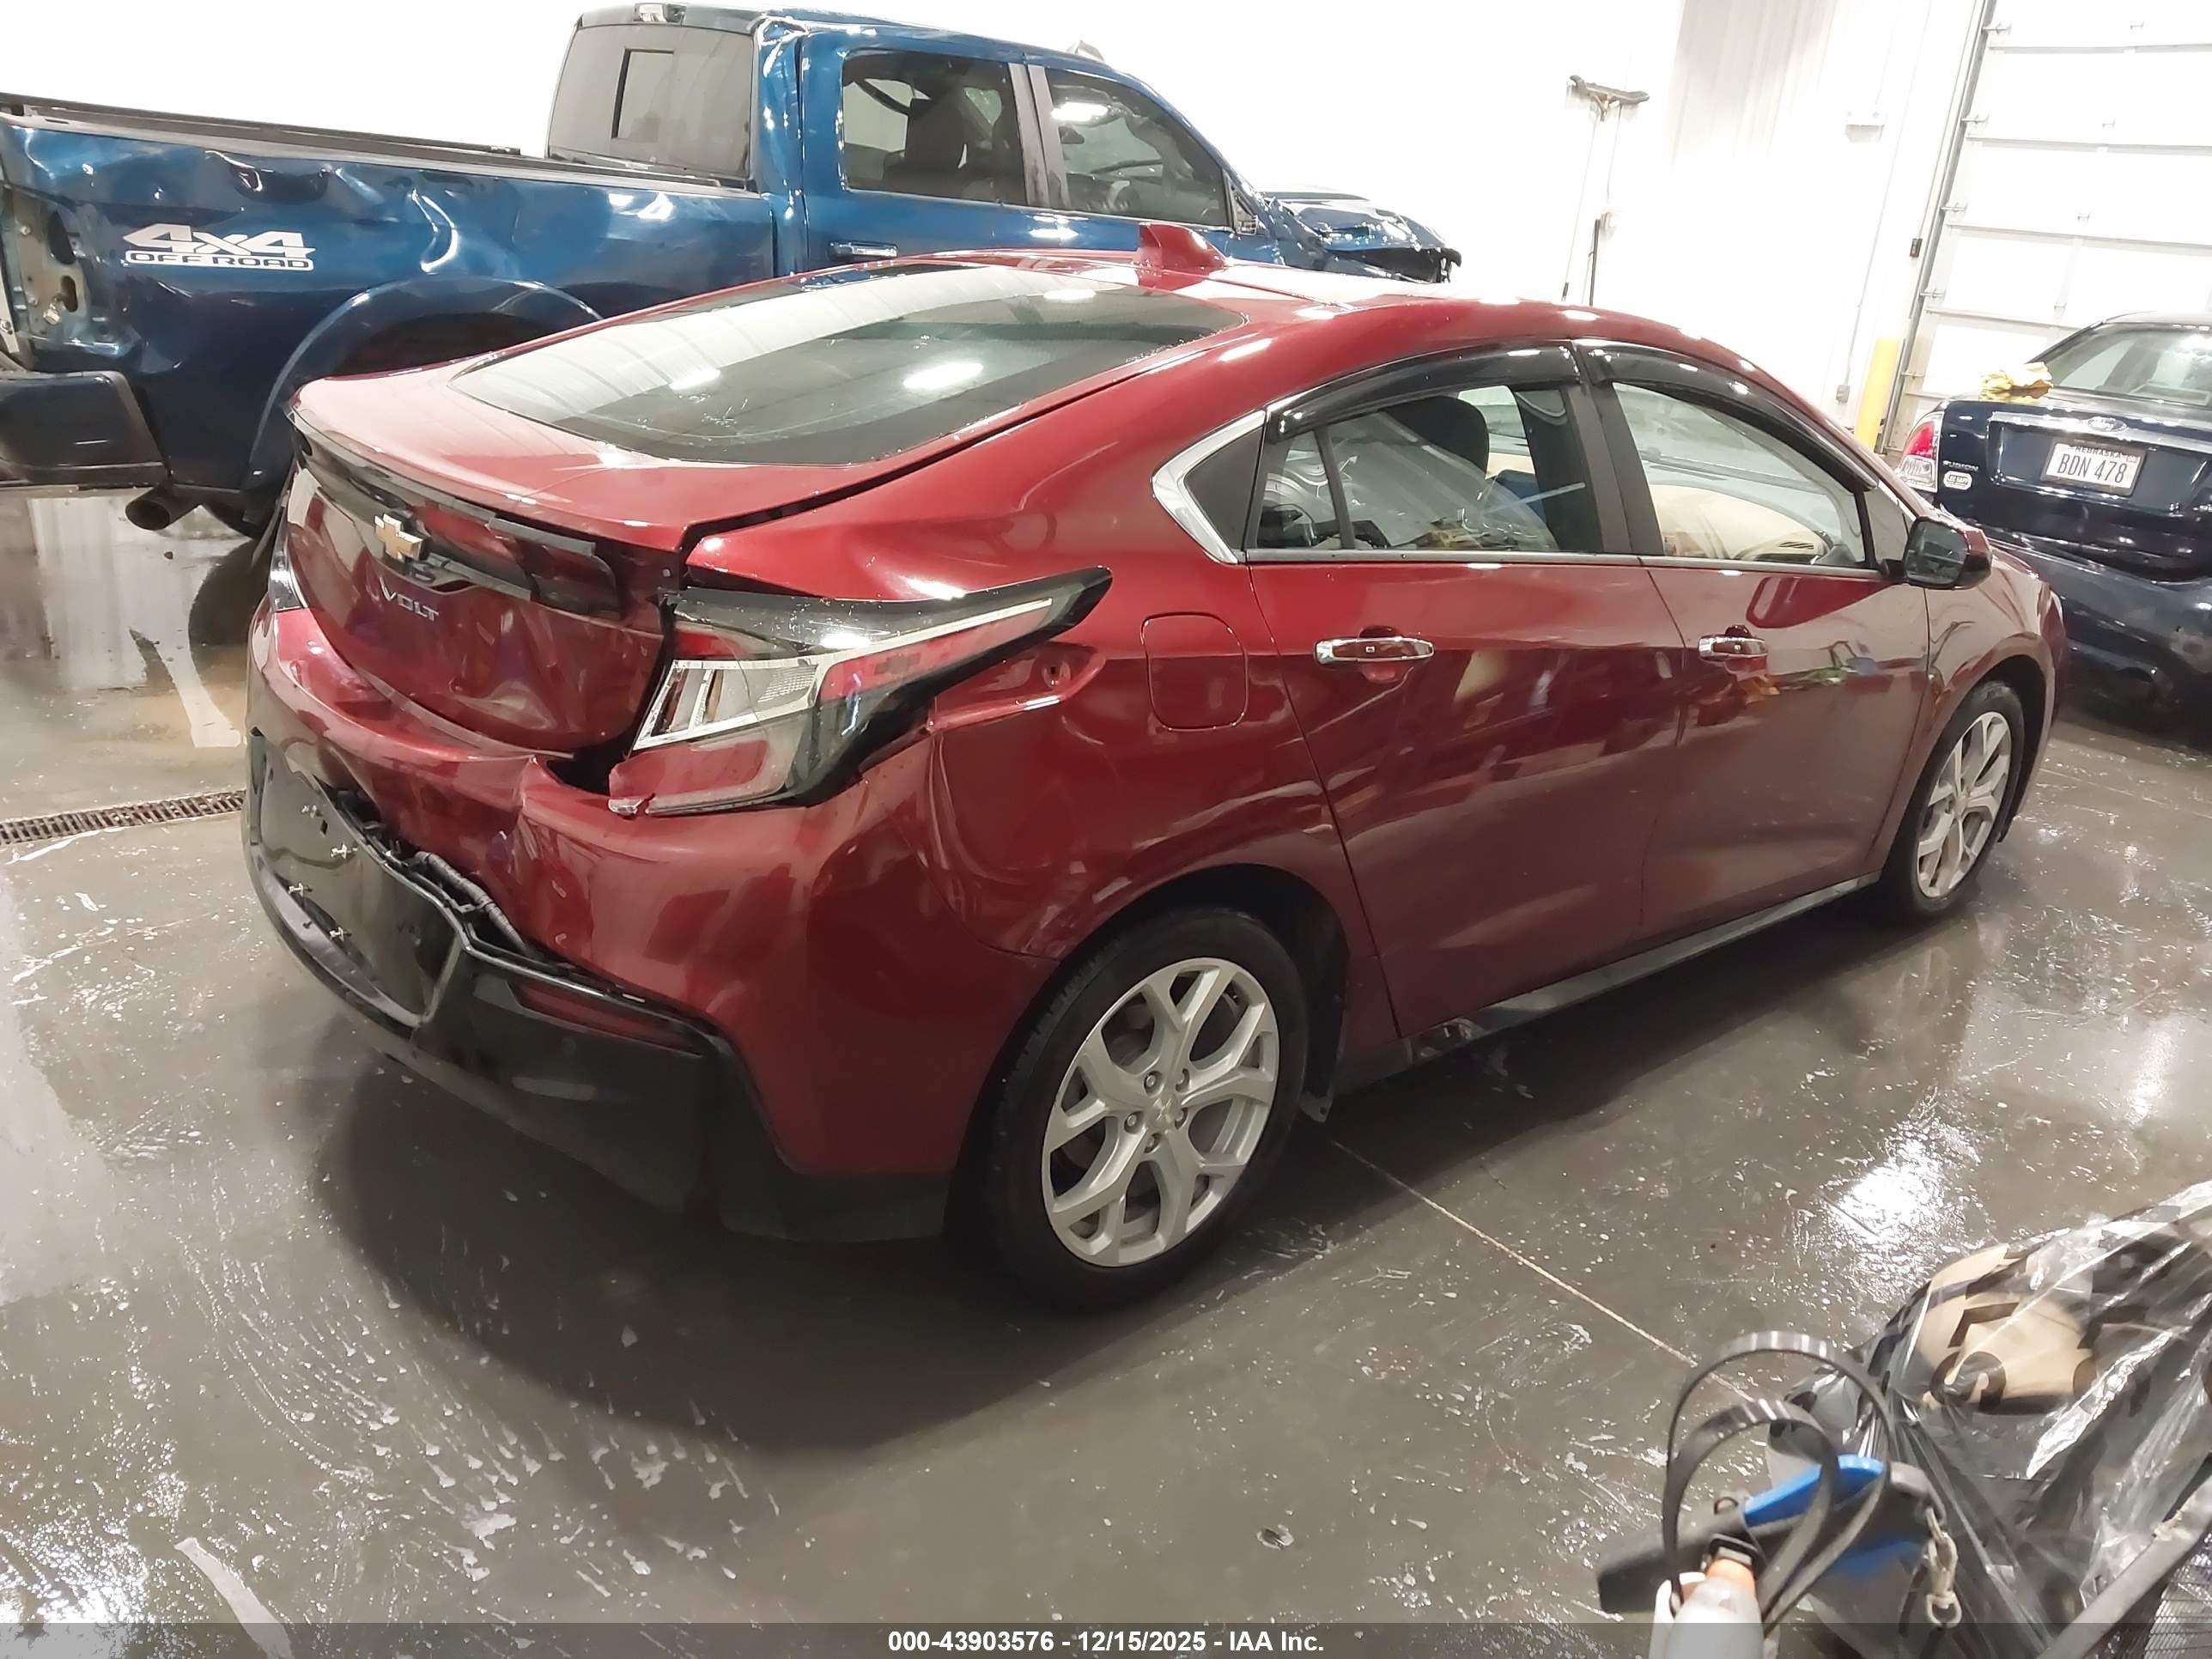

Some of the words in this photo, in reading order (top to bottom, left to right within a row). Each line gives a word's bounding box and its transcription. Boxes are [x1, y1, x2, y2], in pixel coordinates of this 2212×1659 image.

[130, 252, 203, 264] OFF
[212, 256, 309, 269] ROAD
[2057, 453, 2092, 477] BDN
[2094, 459, 2128, 483] 478
[380, 576, 440, 622] VOLT
